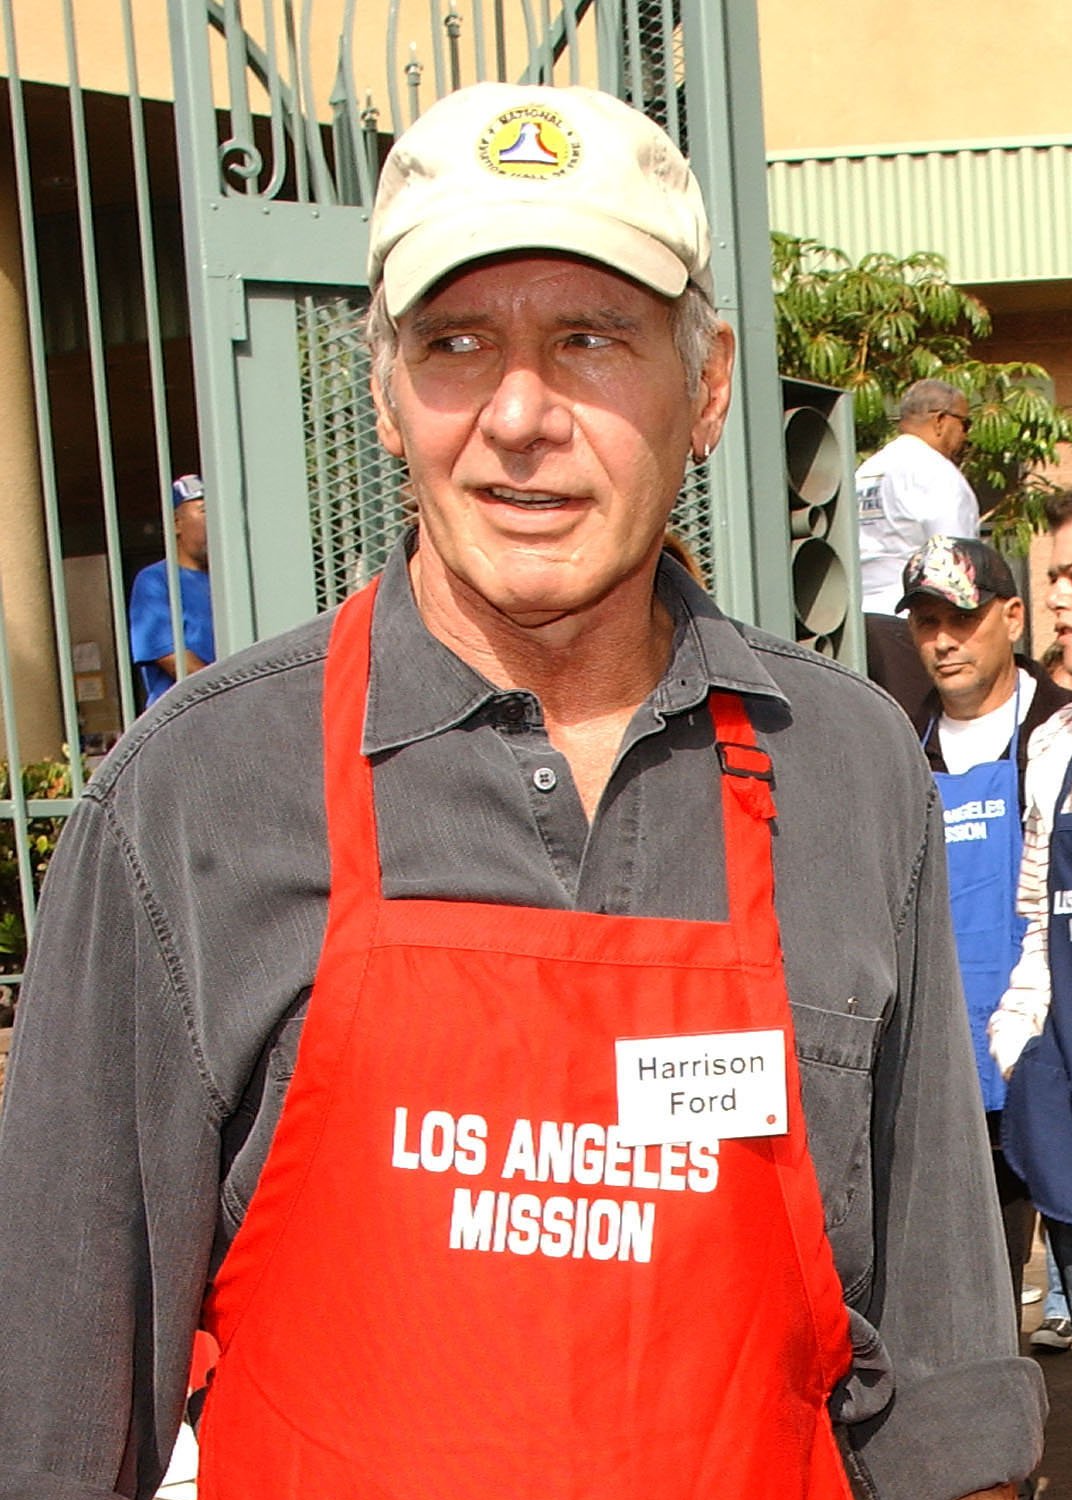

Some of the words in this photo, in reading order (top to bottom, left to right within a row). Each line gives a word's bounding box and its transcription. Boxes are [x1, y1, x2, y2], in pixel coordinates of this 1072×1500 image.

[498, 108, 564, 129] NATIONAL
[638, 1052, 766, 1081] Harrison
[670, 1088, 737, 1116] Ford
[391, 1107, 488, 1176] LOS
[502, 1119, 720, 1193] ANGELES
[448, 1188, 656, 1263] MISSION
